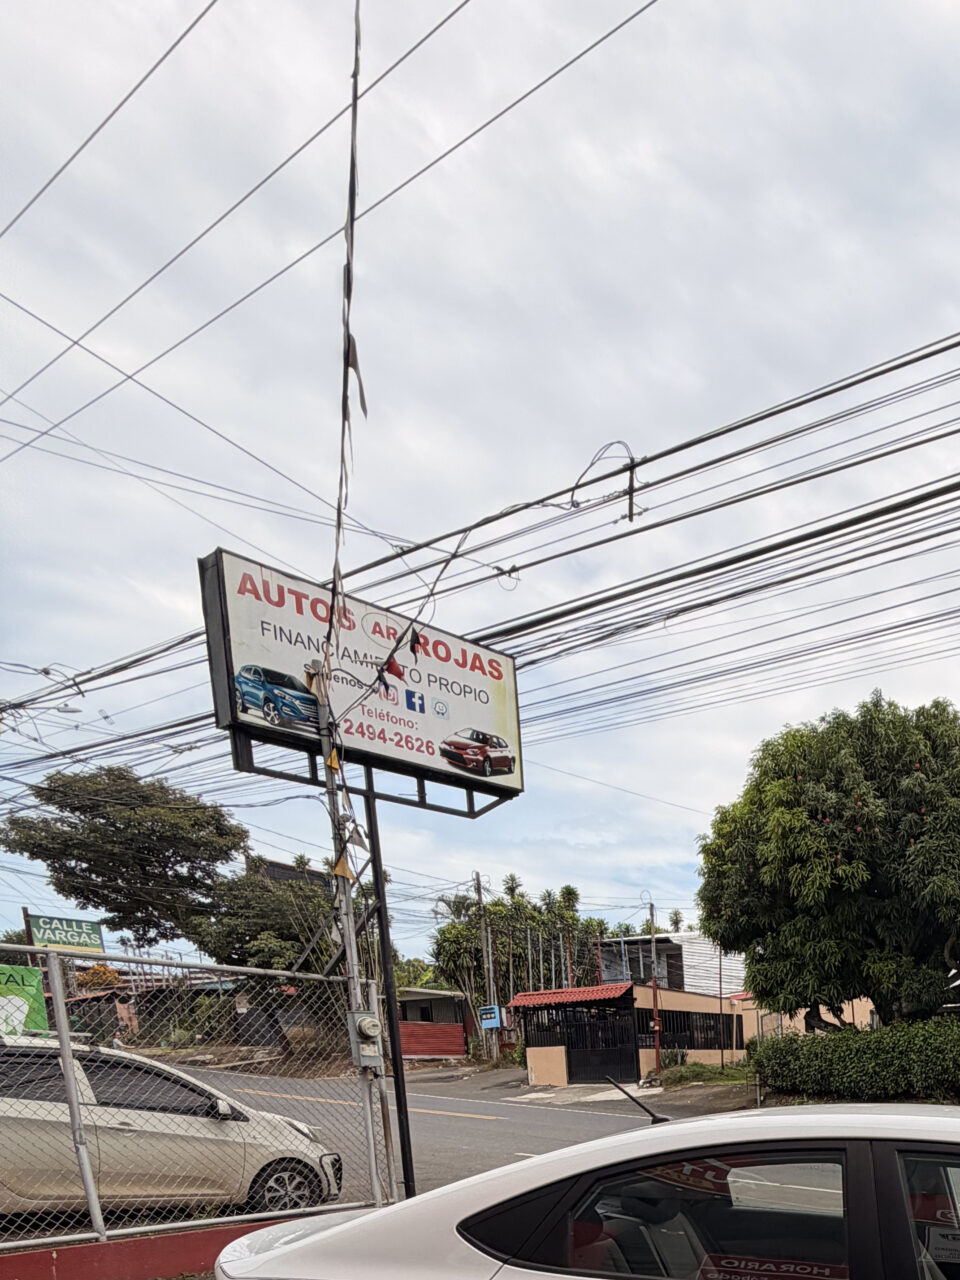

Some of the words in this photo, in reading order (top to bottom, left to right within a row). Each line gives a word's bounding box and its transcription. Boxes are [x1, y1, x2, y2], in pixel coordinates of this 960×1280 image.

[237, 572, 356, 631] AUTOS
[371, 621, 398, 641] AR
[414, 633, 504, 681] ROJAS
[427, 673, 490, 705] PROPIO
[360, 704, 418, 730] Teléfono:
[343, 719, 435, 756] 2494-2626
[33, 928, 101, 944] VARGAS
[39, 918, 92, 933] CALLE
